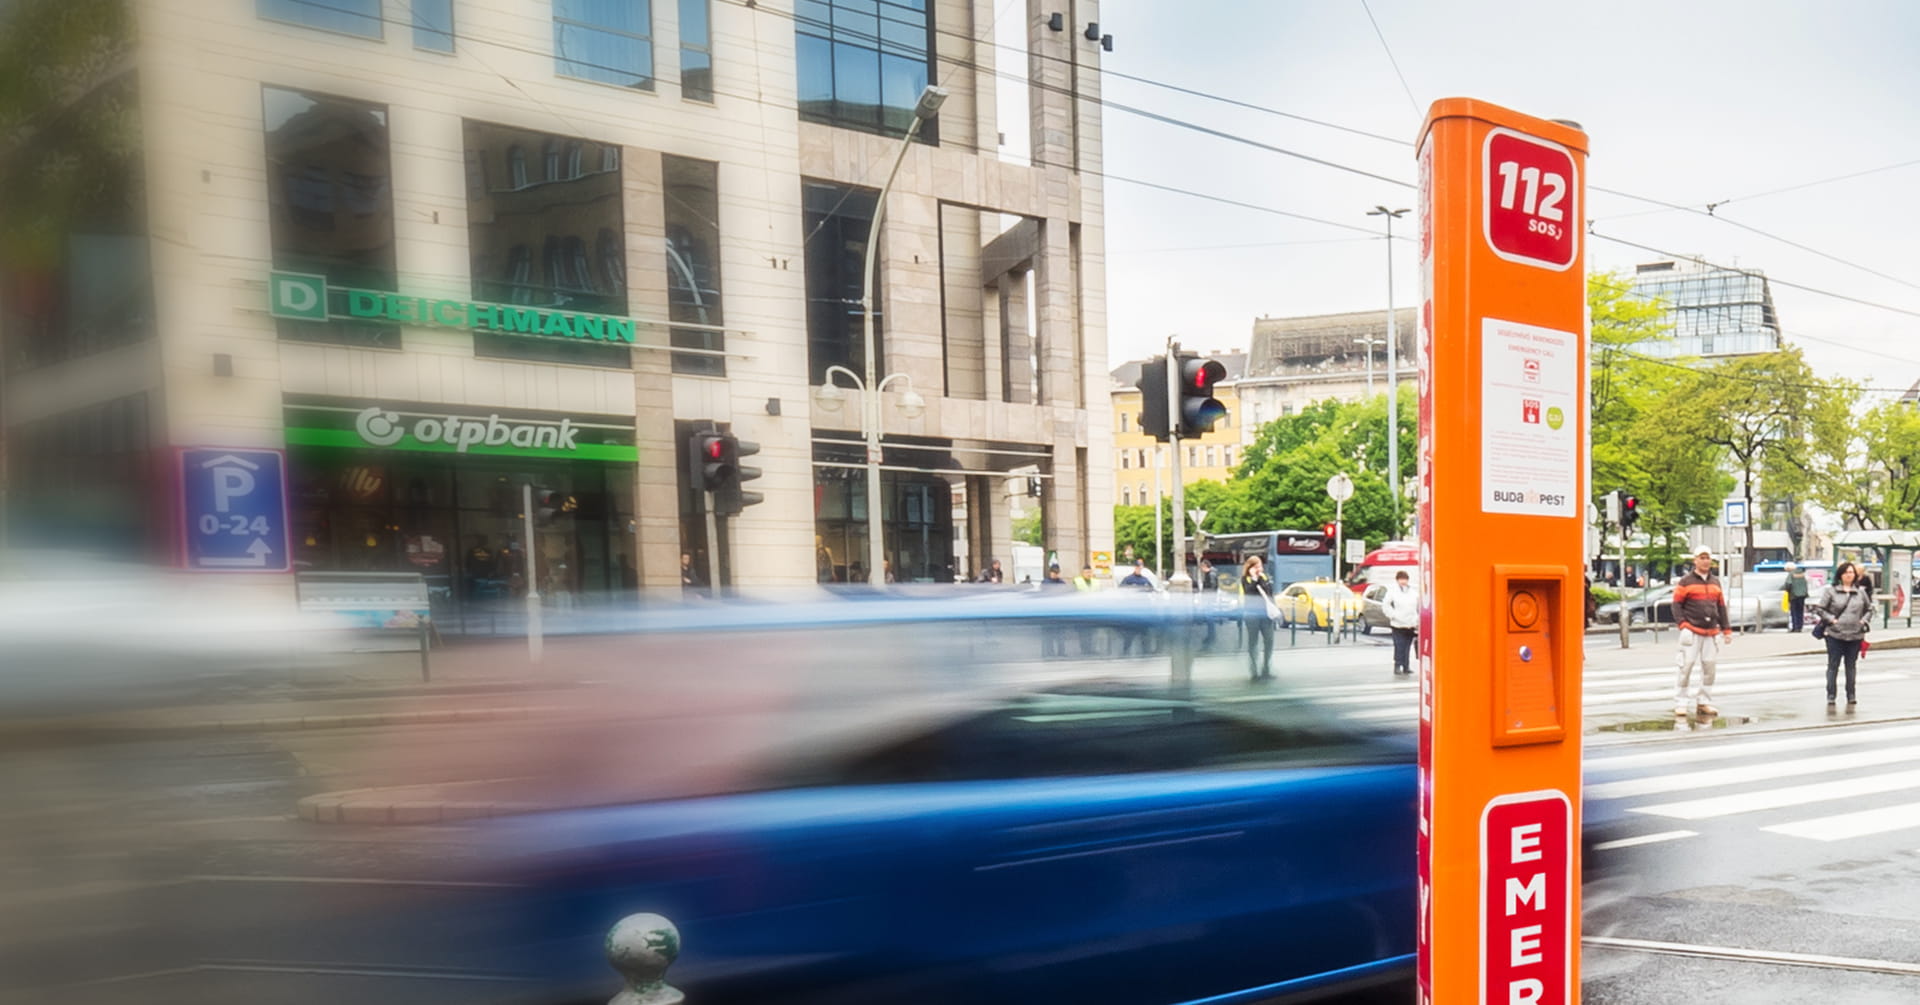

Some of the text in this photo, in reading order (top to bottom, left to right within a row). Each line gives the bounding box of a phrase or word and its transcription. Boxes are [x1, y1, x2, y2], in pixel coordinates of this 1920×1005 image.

[1499, 161, 1566, 222] 112
[279, 279, 637, 343] D DEICHMANN
[414, 414, 579, 453] otpbank
[214, 466, 255, 512] P
[199, 514, 271, 536] 0-24
